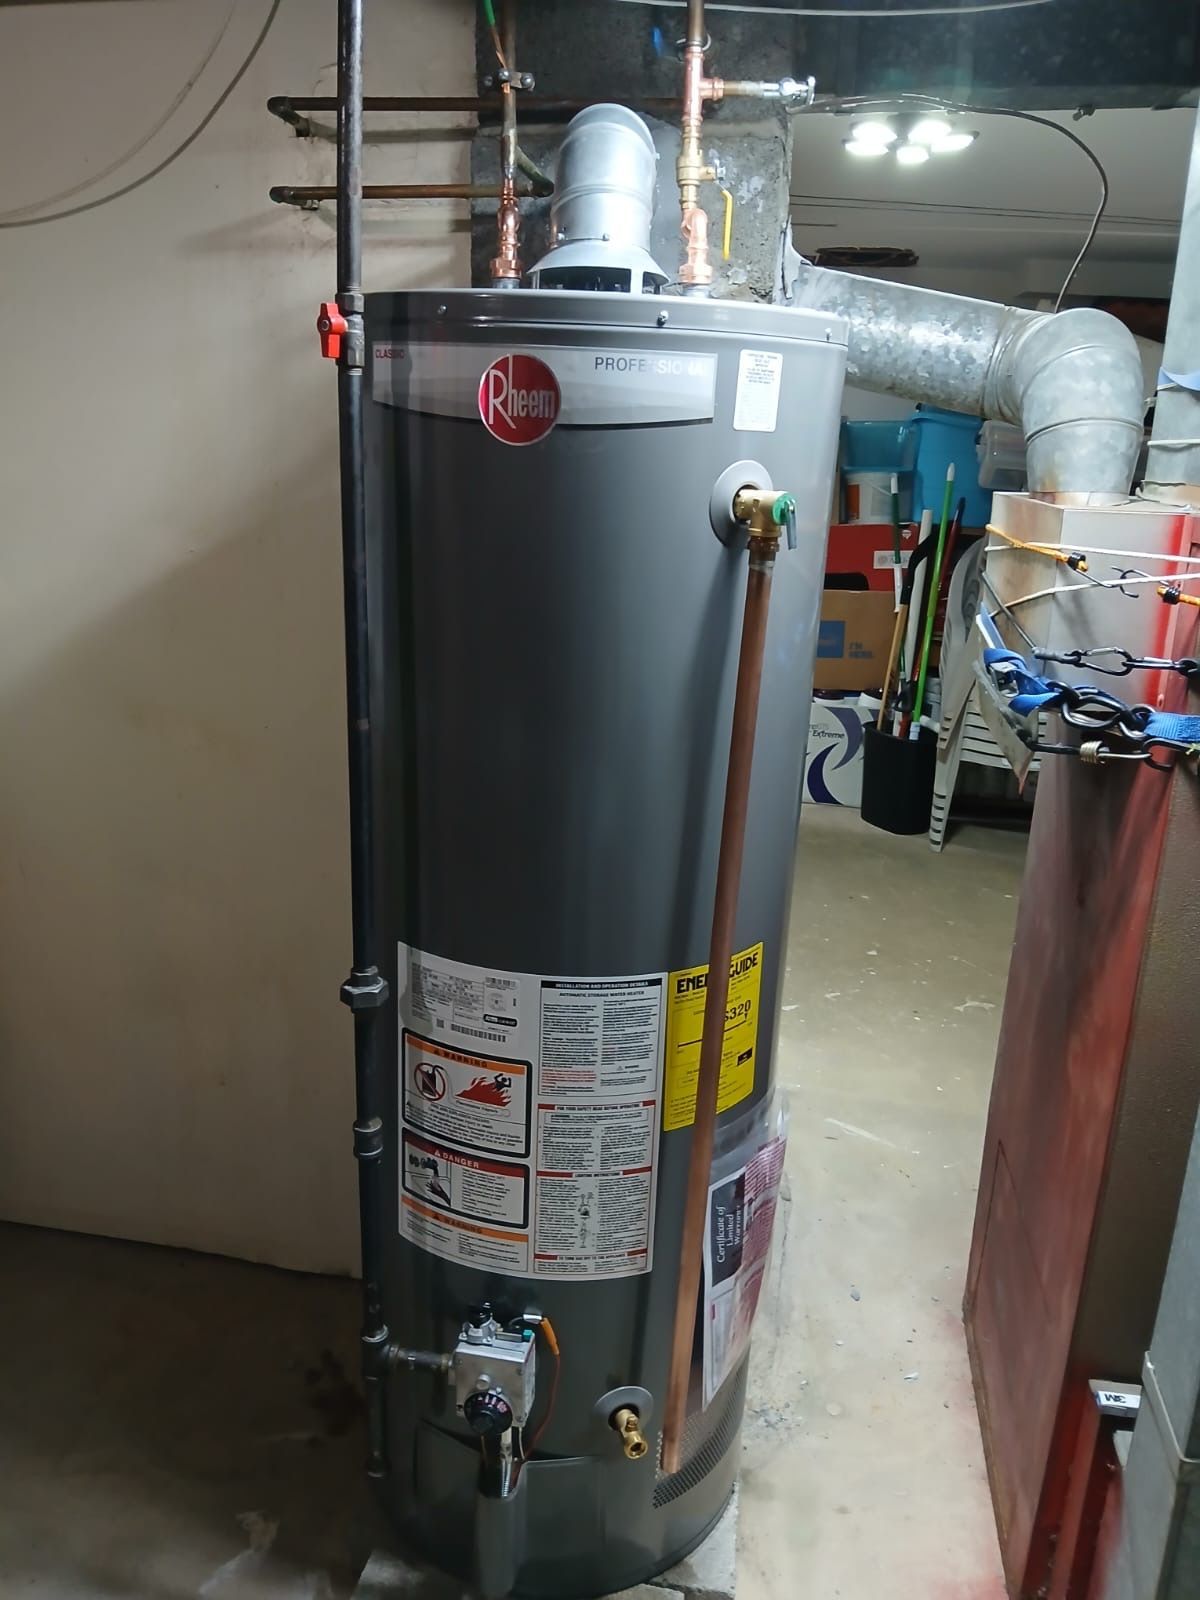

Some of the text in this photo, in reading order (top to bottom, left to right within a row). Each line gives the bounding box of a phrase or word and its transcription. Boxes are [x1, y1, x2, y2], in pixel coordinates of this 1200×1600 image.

[488, 354, 555, 429] Rheem
[812, 729, 845, 739] Extreme
[442, 1152, 479, 1168] DANGER
[715, 1205, 727, 1263] Certificate of
[726, 1214, 734, 1246] Limited
